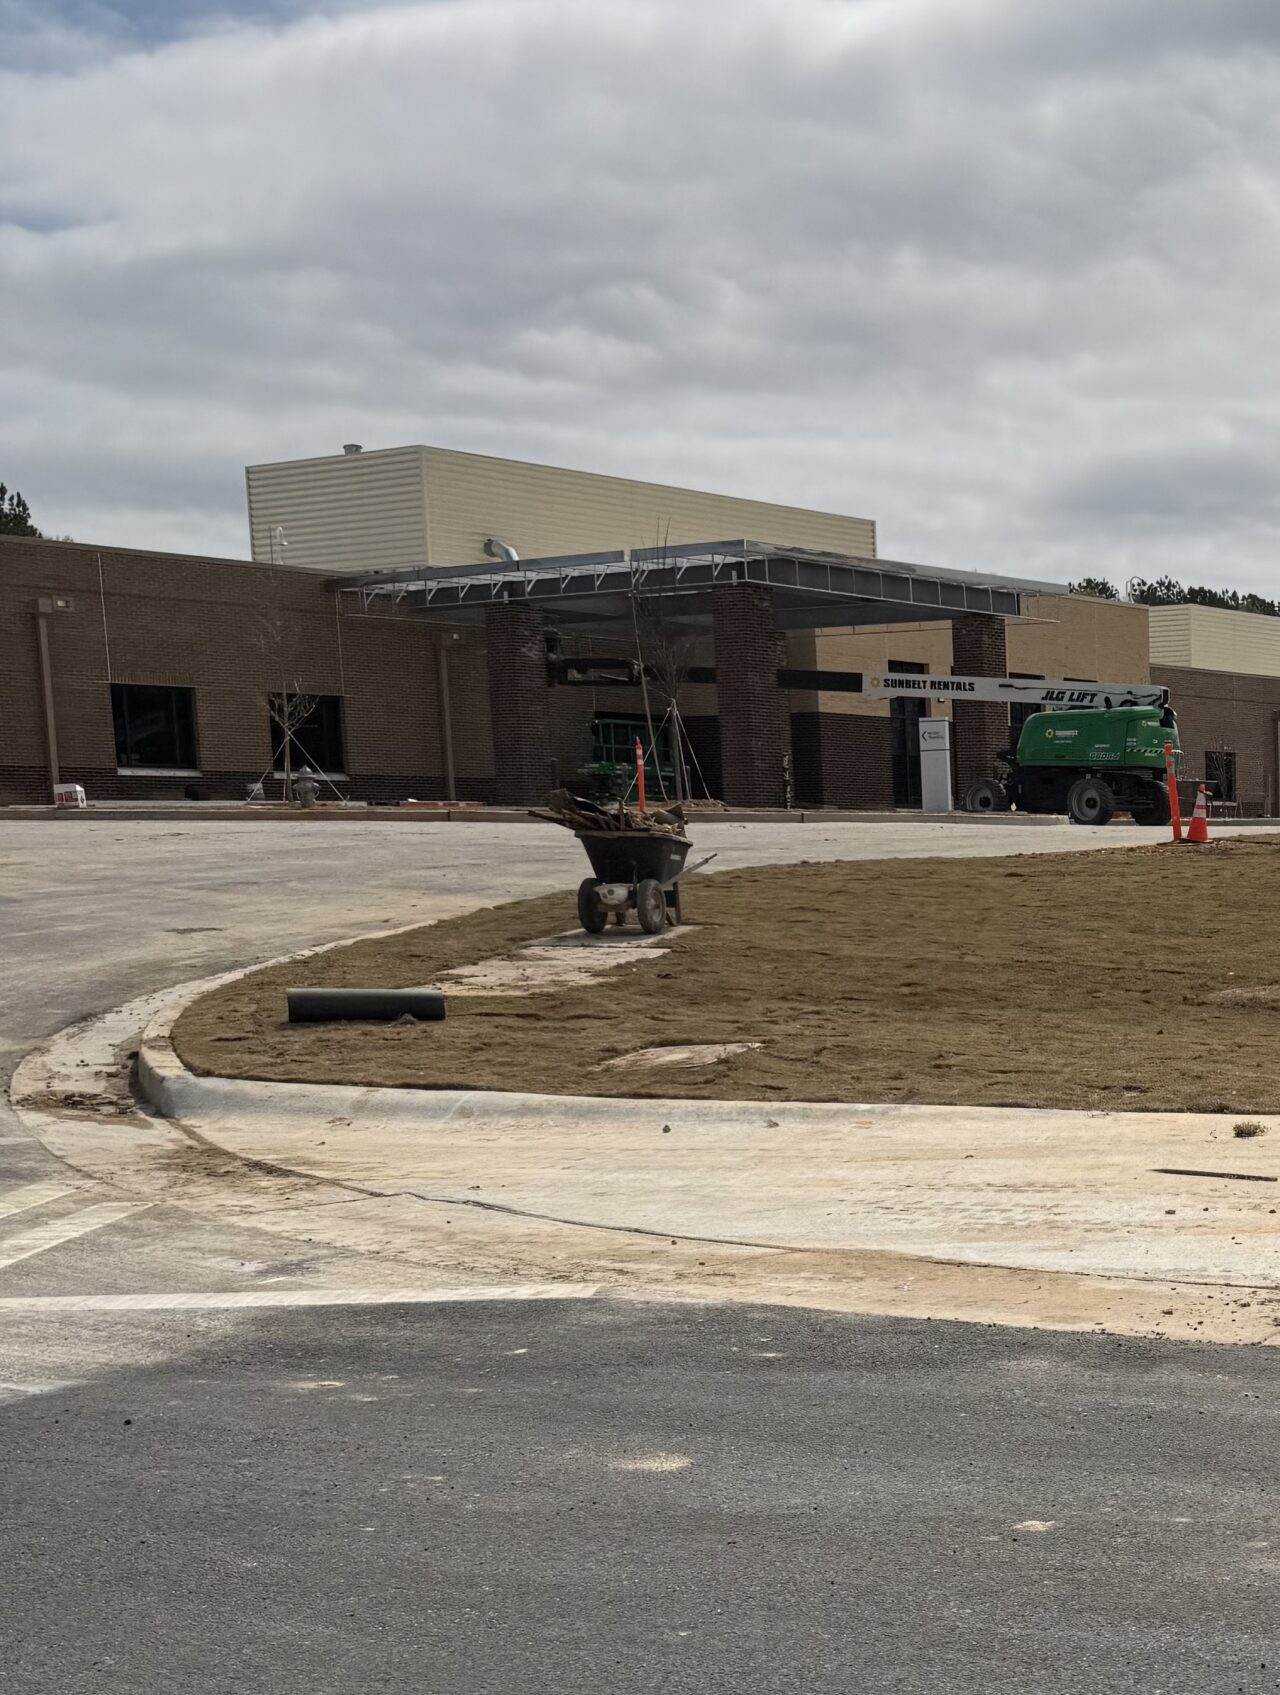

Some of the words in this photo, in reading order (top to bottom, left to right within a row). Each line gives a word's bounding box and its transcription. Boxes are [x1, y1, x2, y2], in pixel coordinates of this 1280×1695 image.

[883, 679, 928, 690] SUNBELT
[930, 680, 975, 692] RENTALS
[1041, 690, 1066, 701] JLG
[1068, 692, 1098, 703] LIFT
